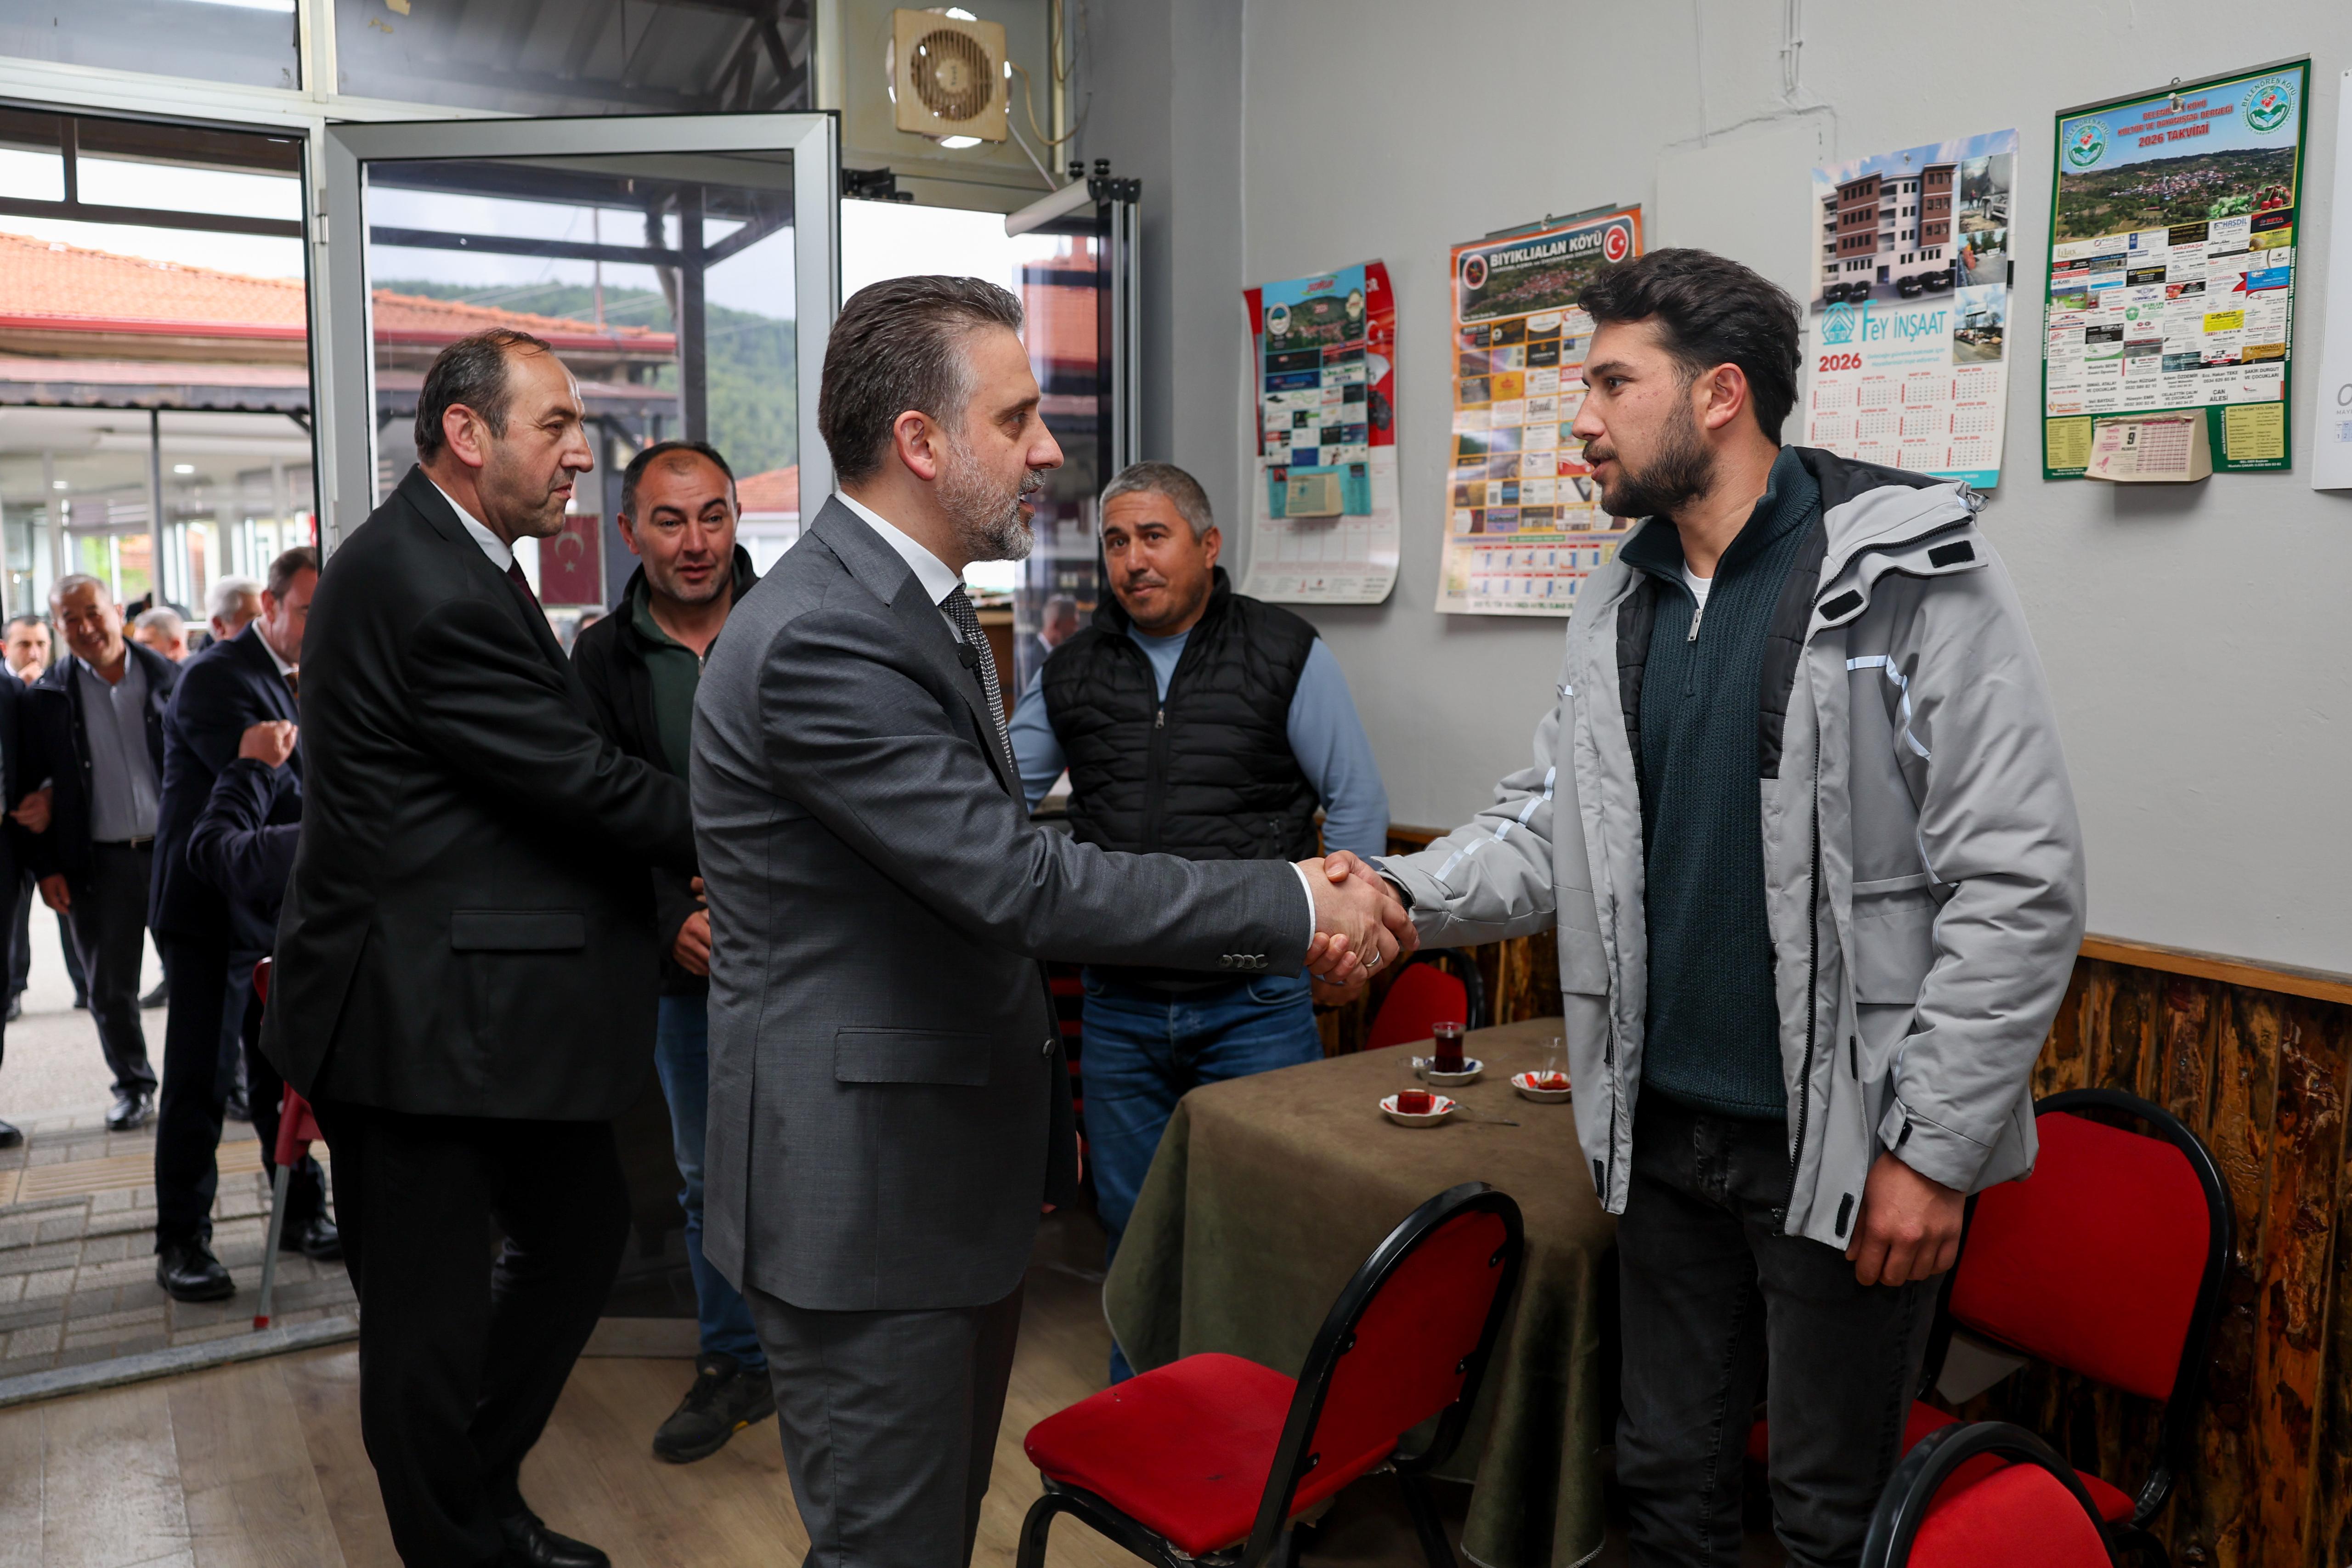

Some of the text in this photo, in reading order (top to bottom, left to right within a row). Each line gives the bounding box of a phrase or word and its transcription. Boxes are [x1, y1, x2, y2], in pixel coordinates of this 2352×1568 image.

[2139, 121, 2210, 147] 2026 TAKVİMİ
[1490, 230, 1602, 267] BIYIKLIALAN KÖYÜ
[1894, 311, 1947, 342] İNŞAAT
[1819, 353, 1862, 372] 2026
[2127, 432, 2136, 445] 9
